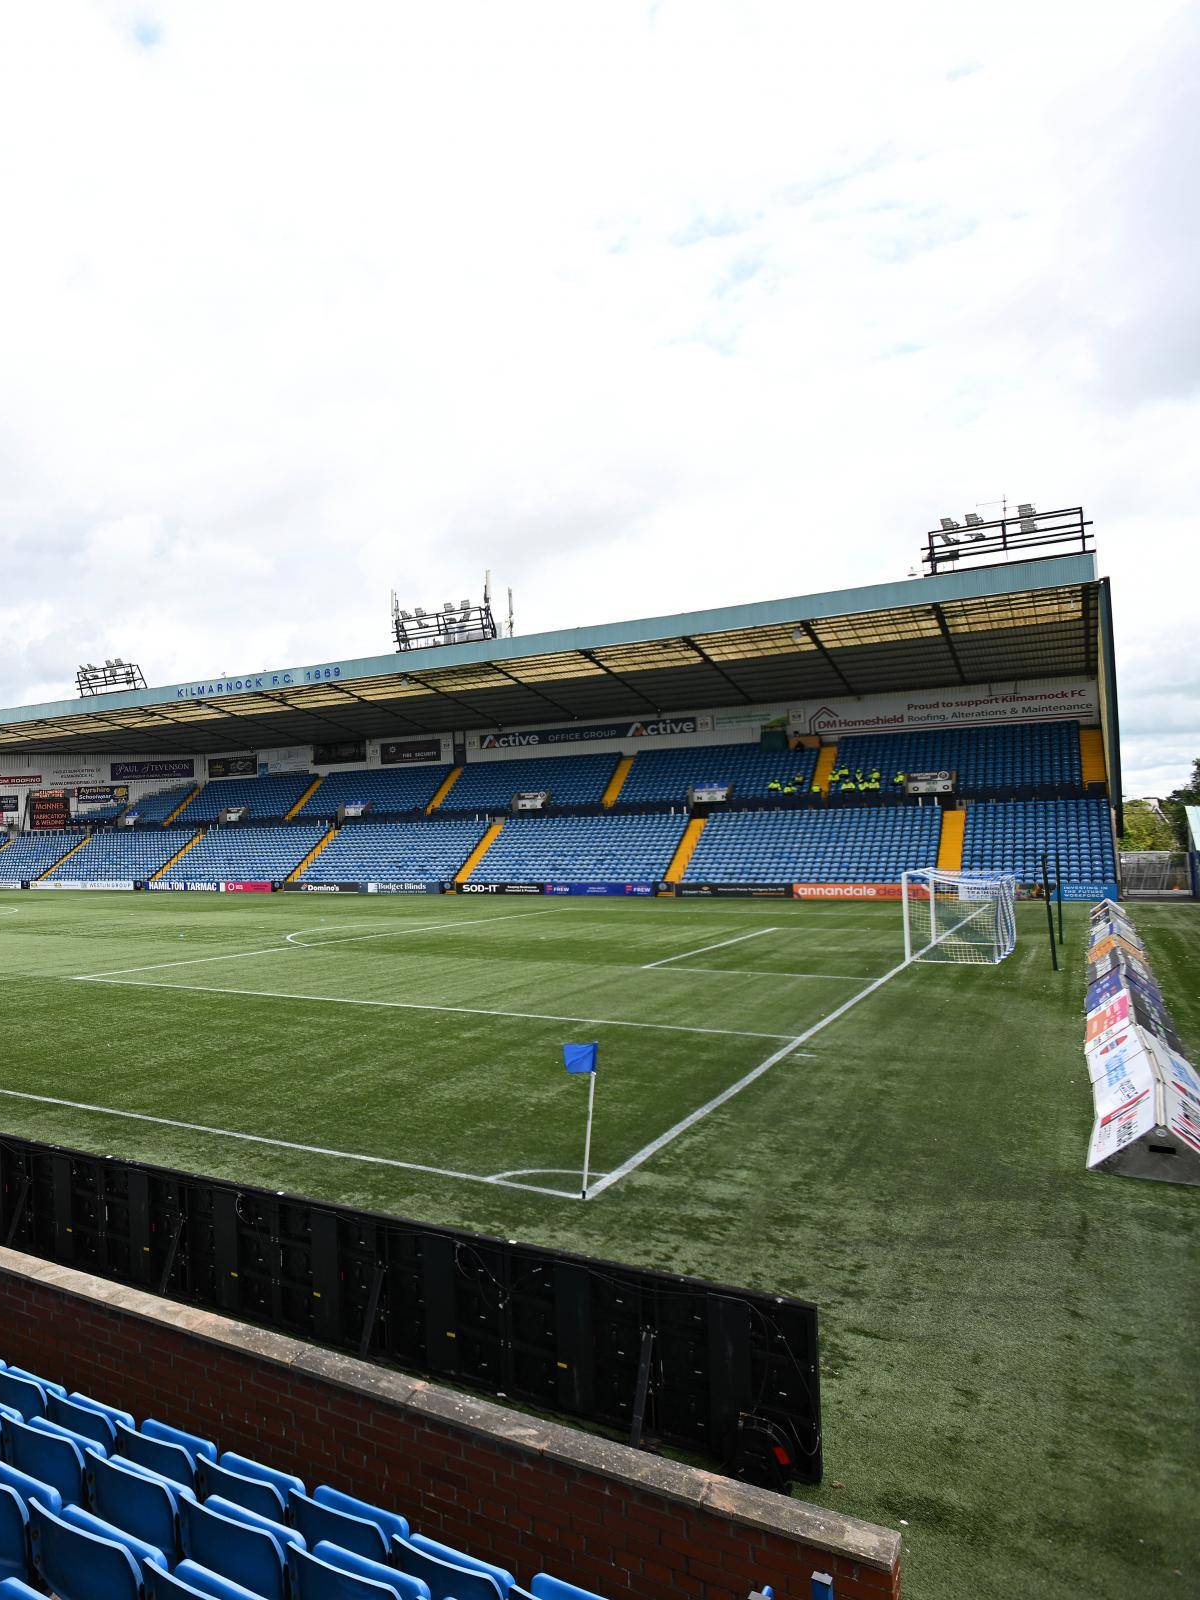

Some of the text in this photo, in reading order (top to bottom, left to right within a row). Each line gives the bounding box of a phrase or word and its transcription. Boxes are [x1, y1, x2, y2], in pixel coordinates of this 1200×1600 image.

[177, 667, 341, 698] KILMARNOCK F.C. 1869
[907, 689, 1087, 711] Proud to support Kilmarnock FC
[908, 702, 1093, 723] Roofing, Alterations & Maintenance
[817, 713, 905, 729] DM Homeshield
[481, 719, 695, 749] Active OFFICE GROUP Active
[114, 764, 138, 775] PAUL
[148, 881, 217, 891] HAMILTON TARMAC
[307, 884, 340, 892] Domino's
[378, 882, 427, 891] Budget Blinds
[462, 884, 498, 893] SOD-IT
[798, 886, 876, 897] annandale
